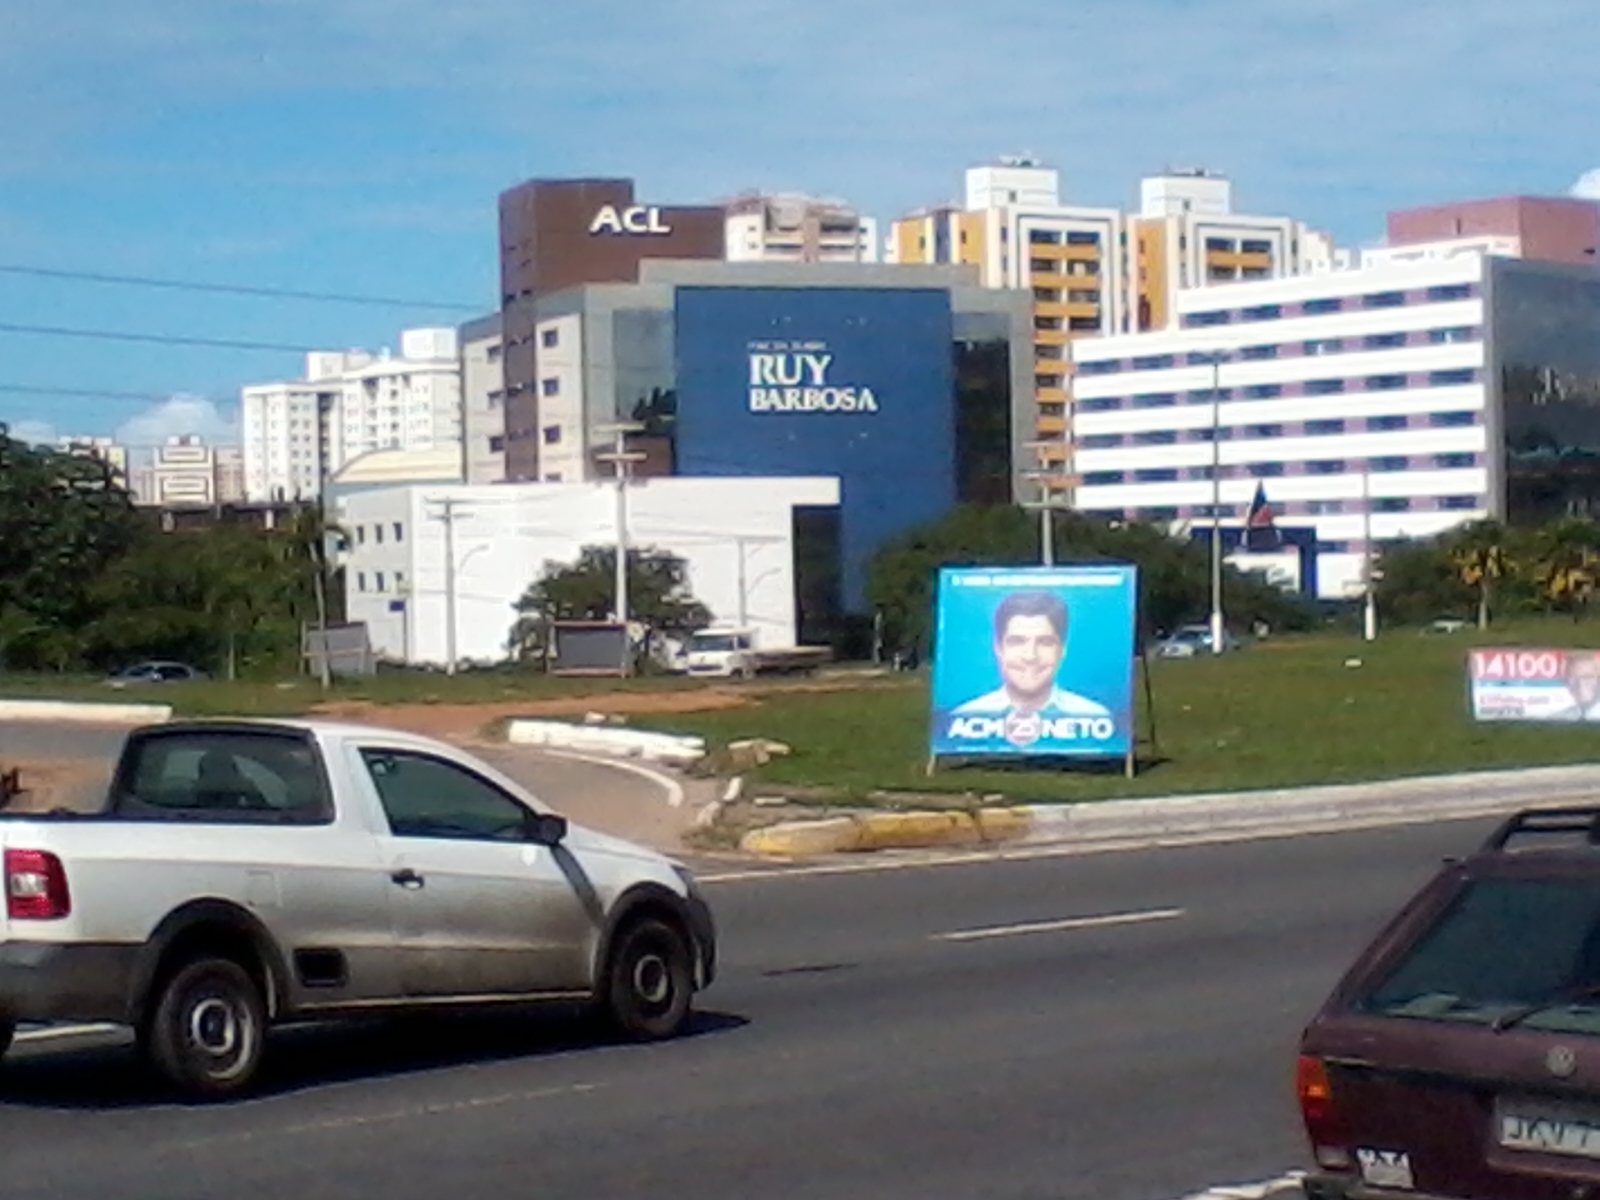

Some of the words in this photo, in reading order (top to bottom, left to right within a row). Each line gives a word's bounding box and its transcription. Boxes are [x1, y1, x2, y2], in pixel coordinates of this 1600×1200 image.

[589, 204, 672, 234] ACL
[749, 354, 832, 386] RUY
[749, 387, 879, 412] BARBOSA
[1475, 652, 1557, 679] 14100
[947, 717, 1005, 740] ACM
[1041, 717, 1114, 740] NETO
